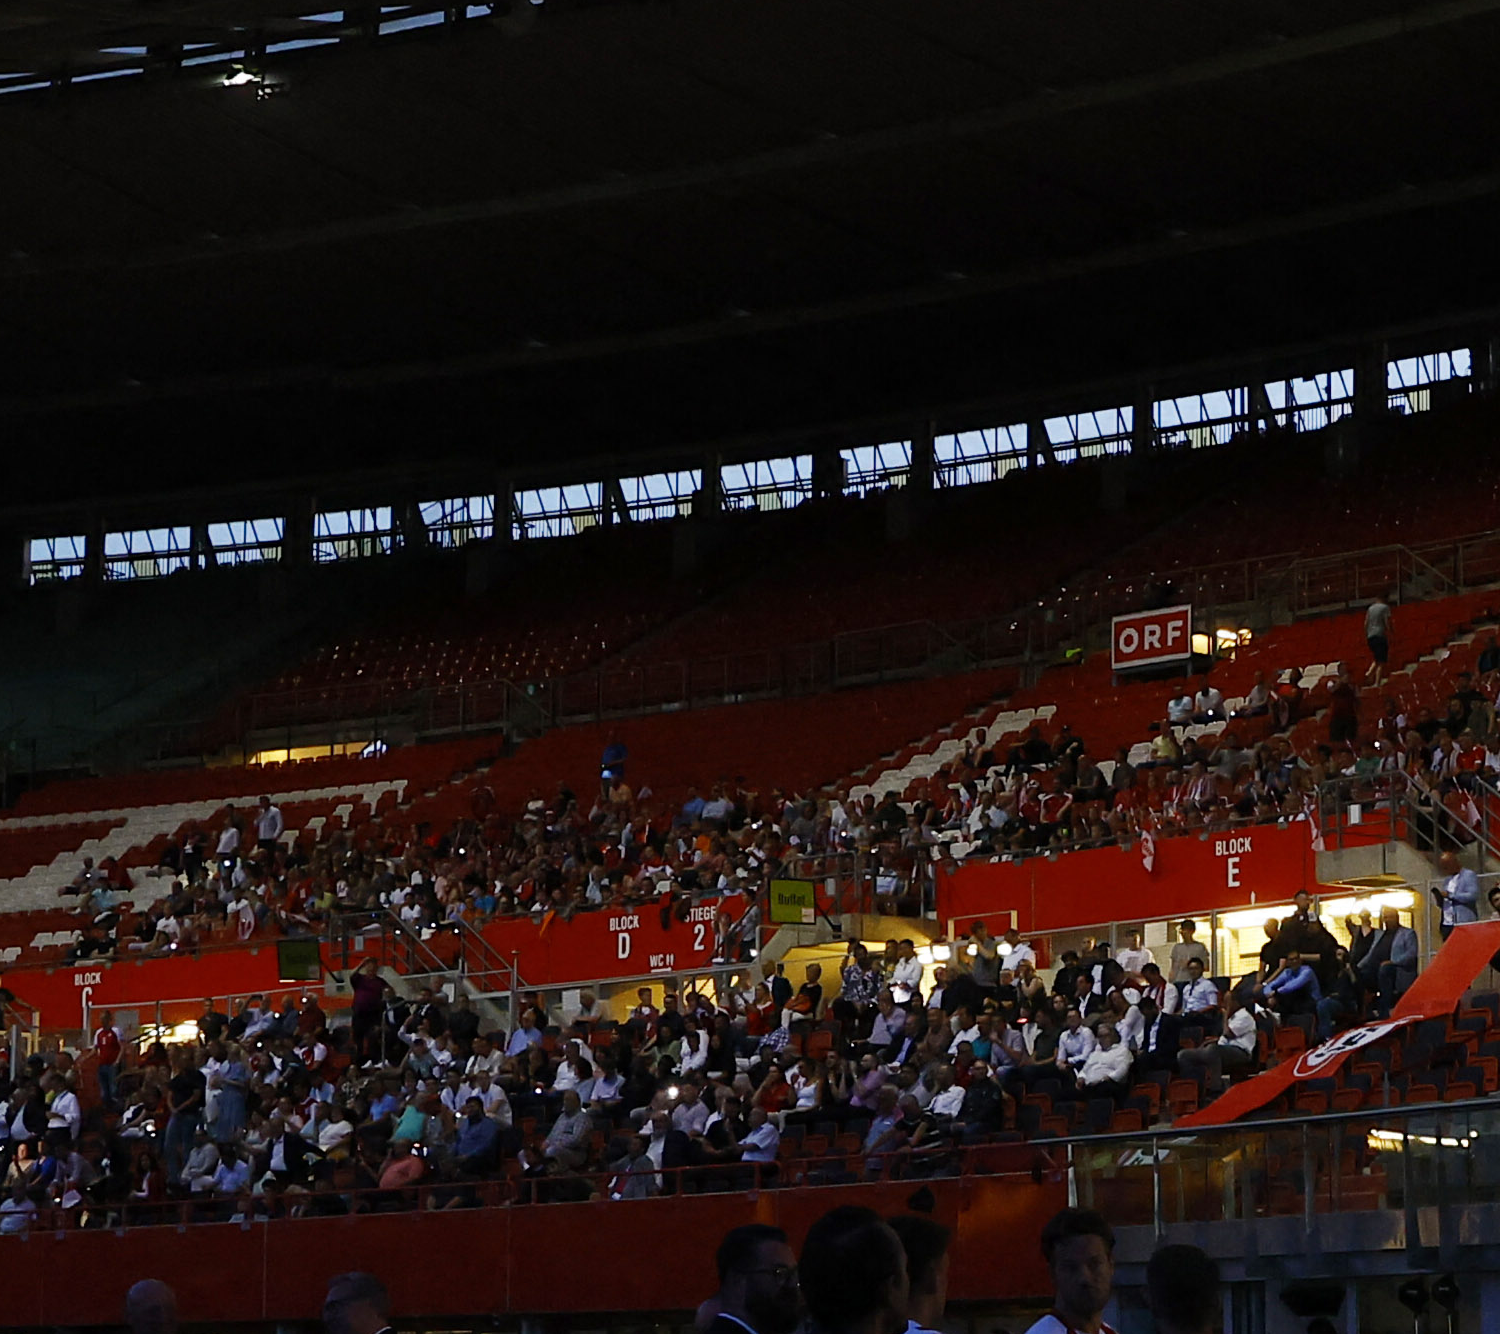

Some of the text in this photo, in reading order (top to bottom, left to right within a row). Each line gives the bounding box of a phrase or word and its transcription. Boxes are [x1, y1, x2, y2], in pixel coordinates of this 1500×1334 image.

[1118, 619, 1184, 654] ORF
[1215, 836, 1252, 856] BLOCK
[1227, 856, 1241, 888] E
[609, 915, 640, 932] BLOCK
[617, 924, 706, 959] D 2
[74, 971, 102, 986] BLOCK
